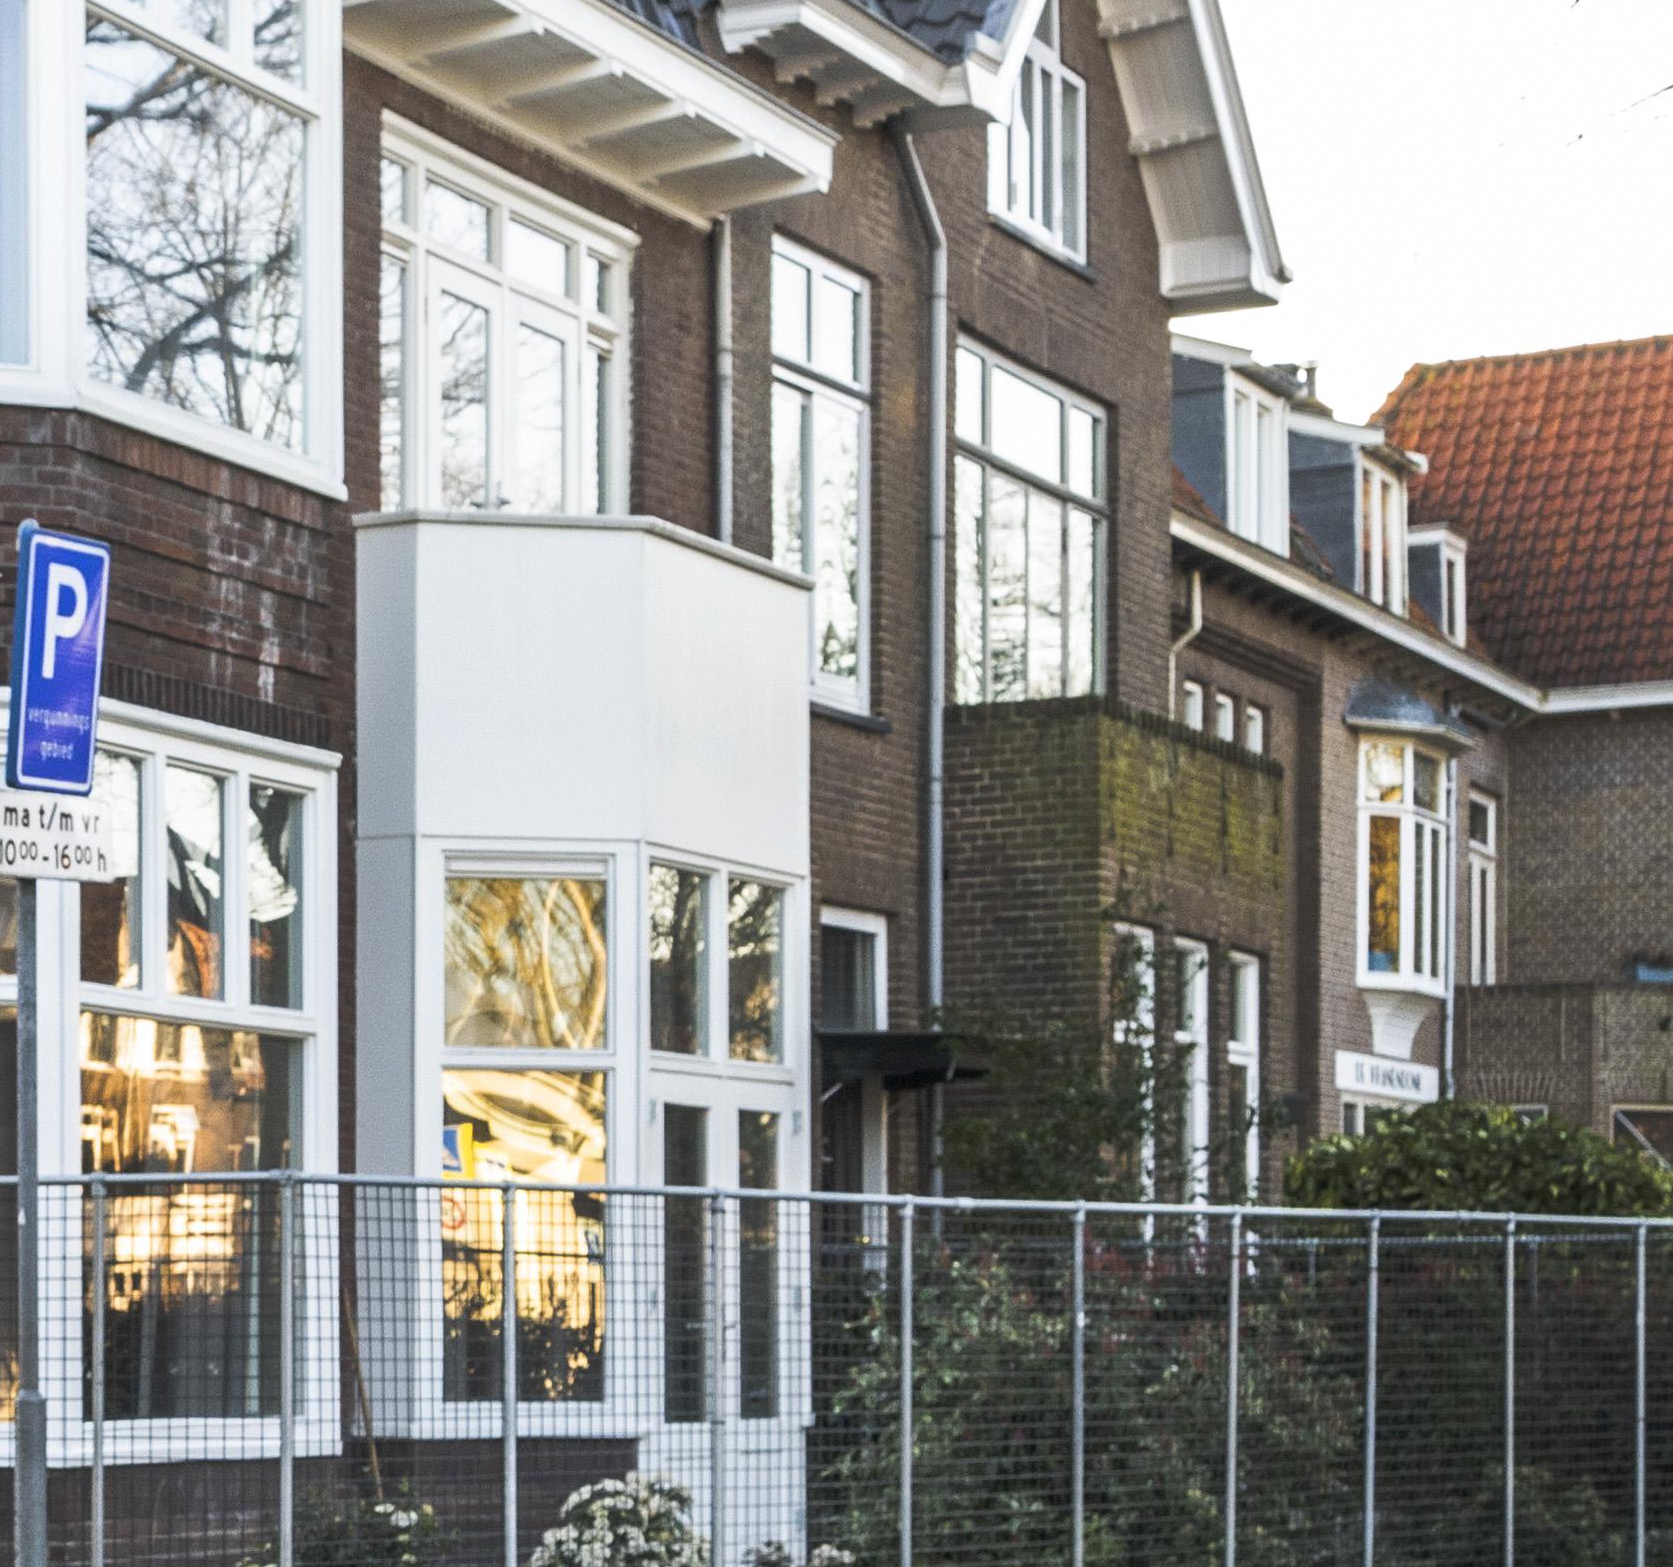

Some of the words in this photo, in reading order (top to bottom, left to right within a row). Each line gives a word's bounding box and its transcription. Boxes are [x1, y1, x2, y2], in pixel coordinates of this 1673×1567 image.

[42, 561, 88, 679] P
[4, 805, 30, 827] ma
[39, 802, 73, 832] t/m
[82, 815, 99, 833] vr
